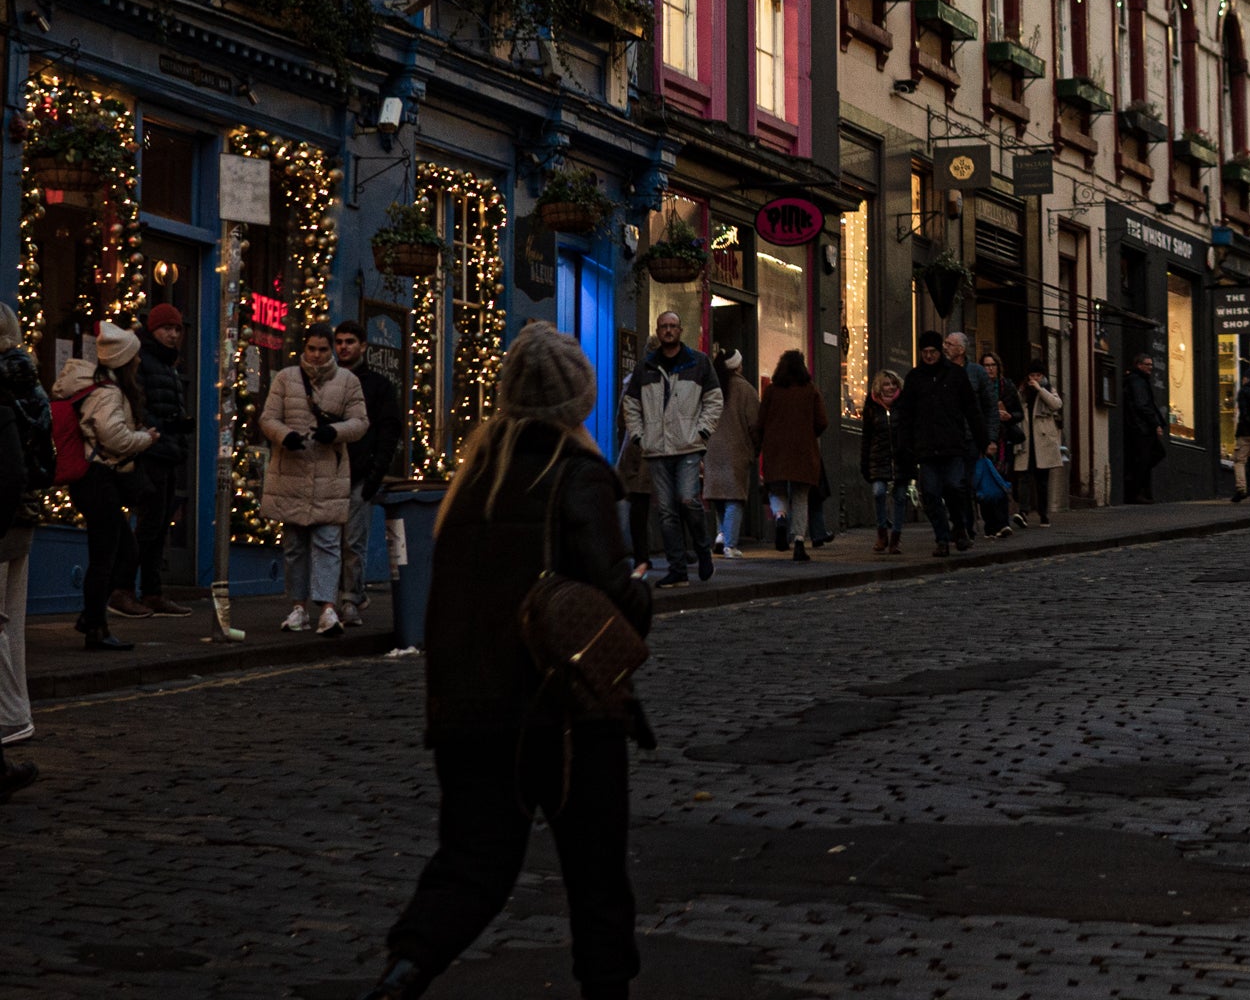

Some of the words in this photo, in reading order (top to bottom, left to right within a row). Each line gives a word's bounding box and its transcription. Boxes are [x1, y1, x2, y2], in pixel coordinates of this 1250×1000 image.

[766, 205, 813, 234] PINK
[1126, 217, 1142, 240] THE
[1141, 223, 1172, 252] WHISKY
[1172, 237, 1193, 259] SHOP
[1225, 293, 1246, 302] THE
[1222, 320, 1250, 329] SHOP
